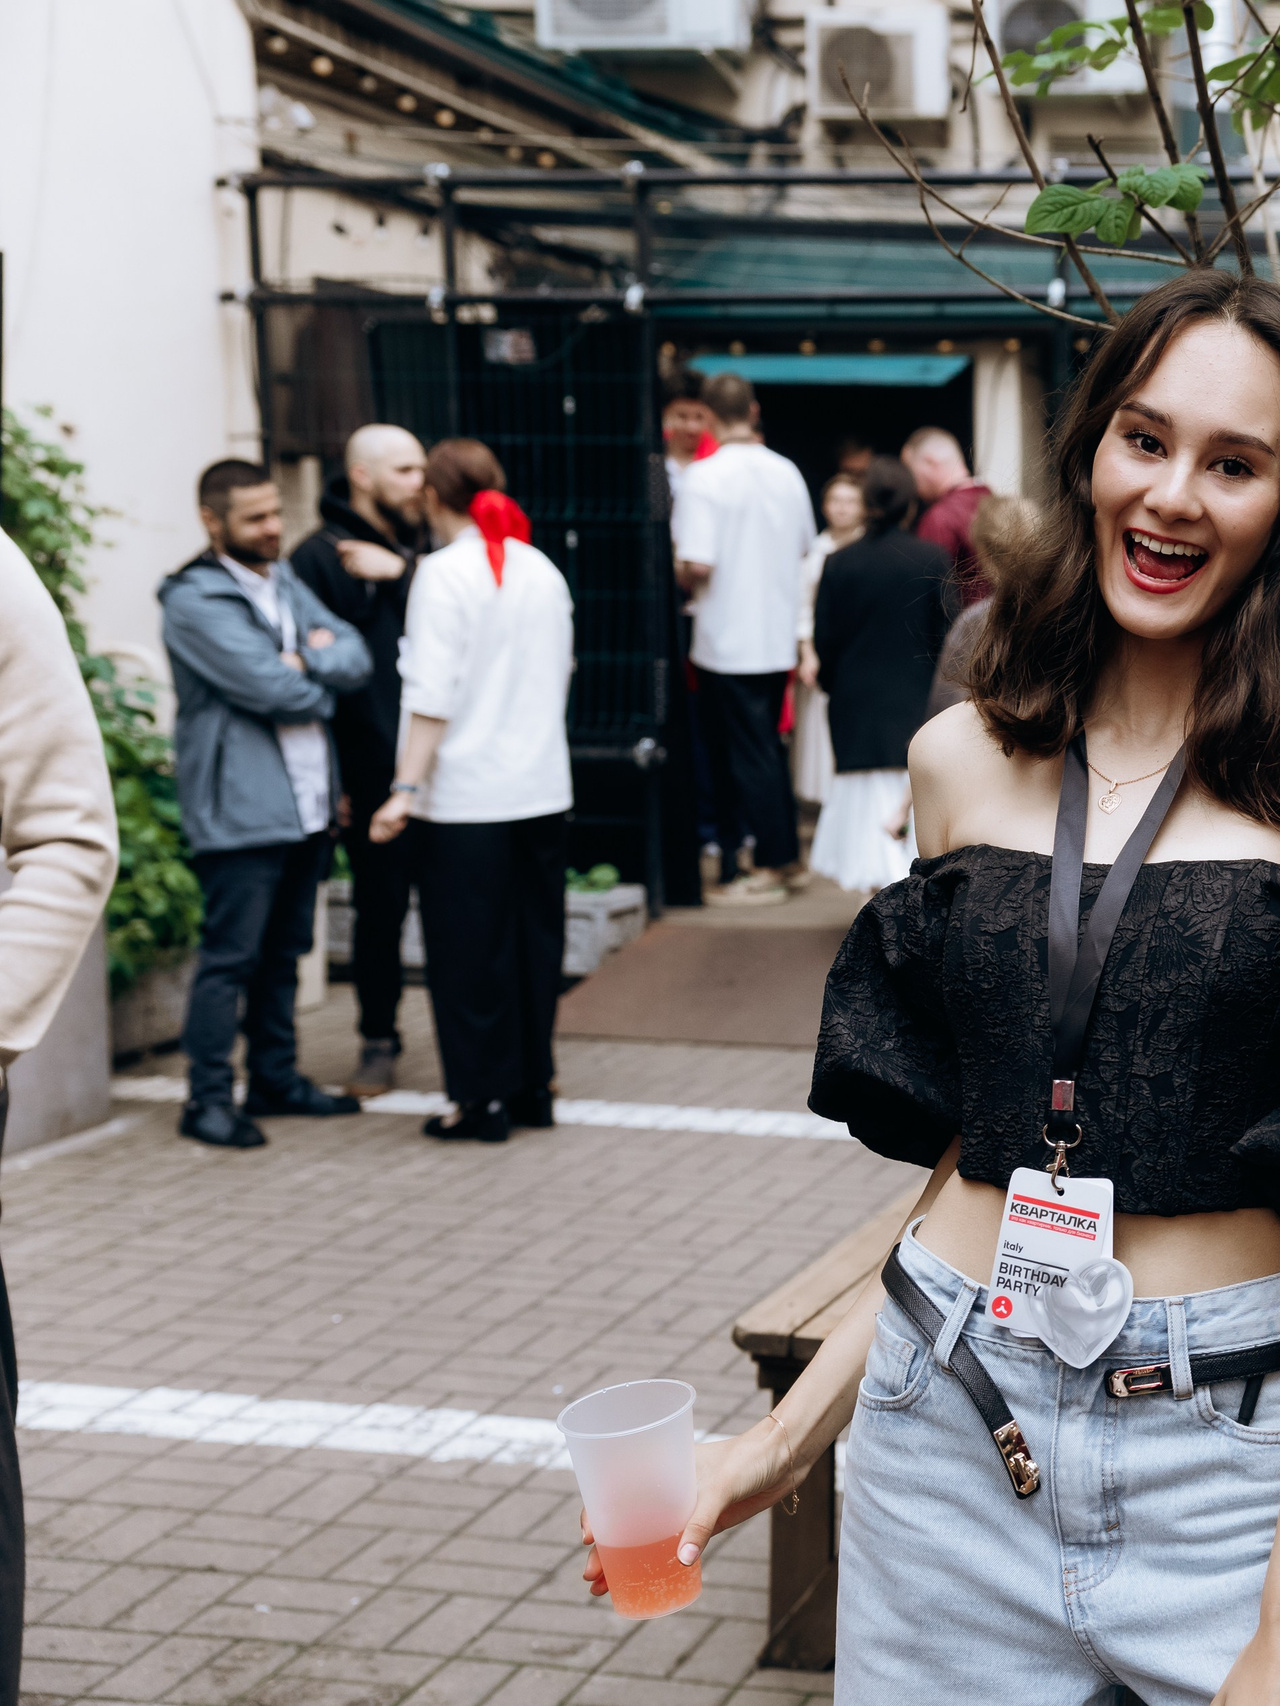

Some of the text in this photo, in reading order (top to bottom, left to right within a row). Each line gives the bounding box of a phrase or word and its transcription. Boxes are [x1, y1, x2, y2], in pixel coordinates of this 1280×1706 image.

[1010, 1202, 1097, 1232] КВАРТАЛКА
[1003, 1240, 1024, 1253] italy
[996, 1276, 1041, 1297] PARTY
[999, 1262, 1068, 1288] BIRTHDAY
